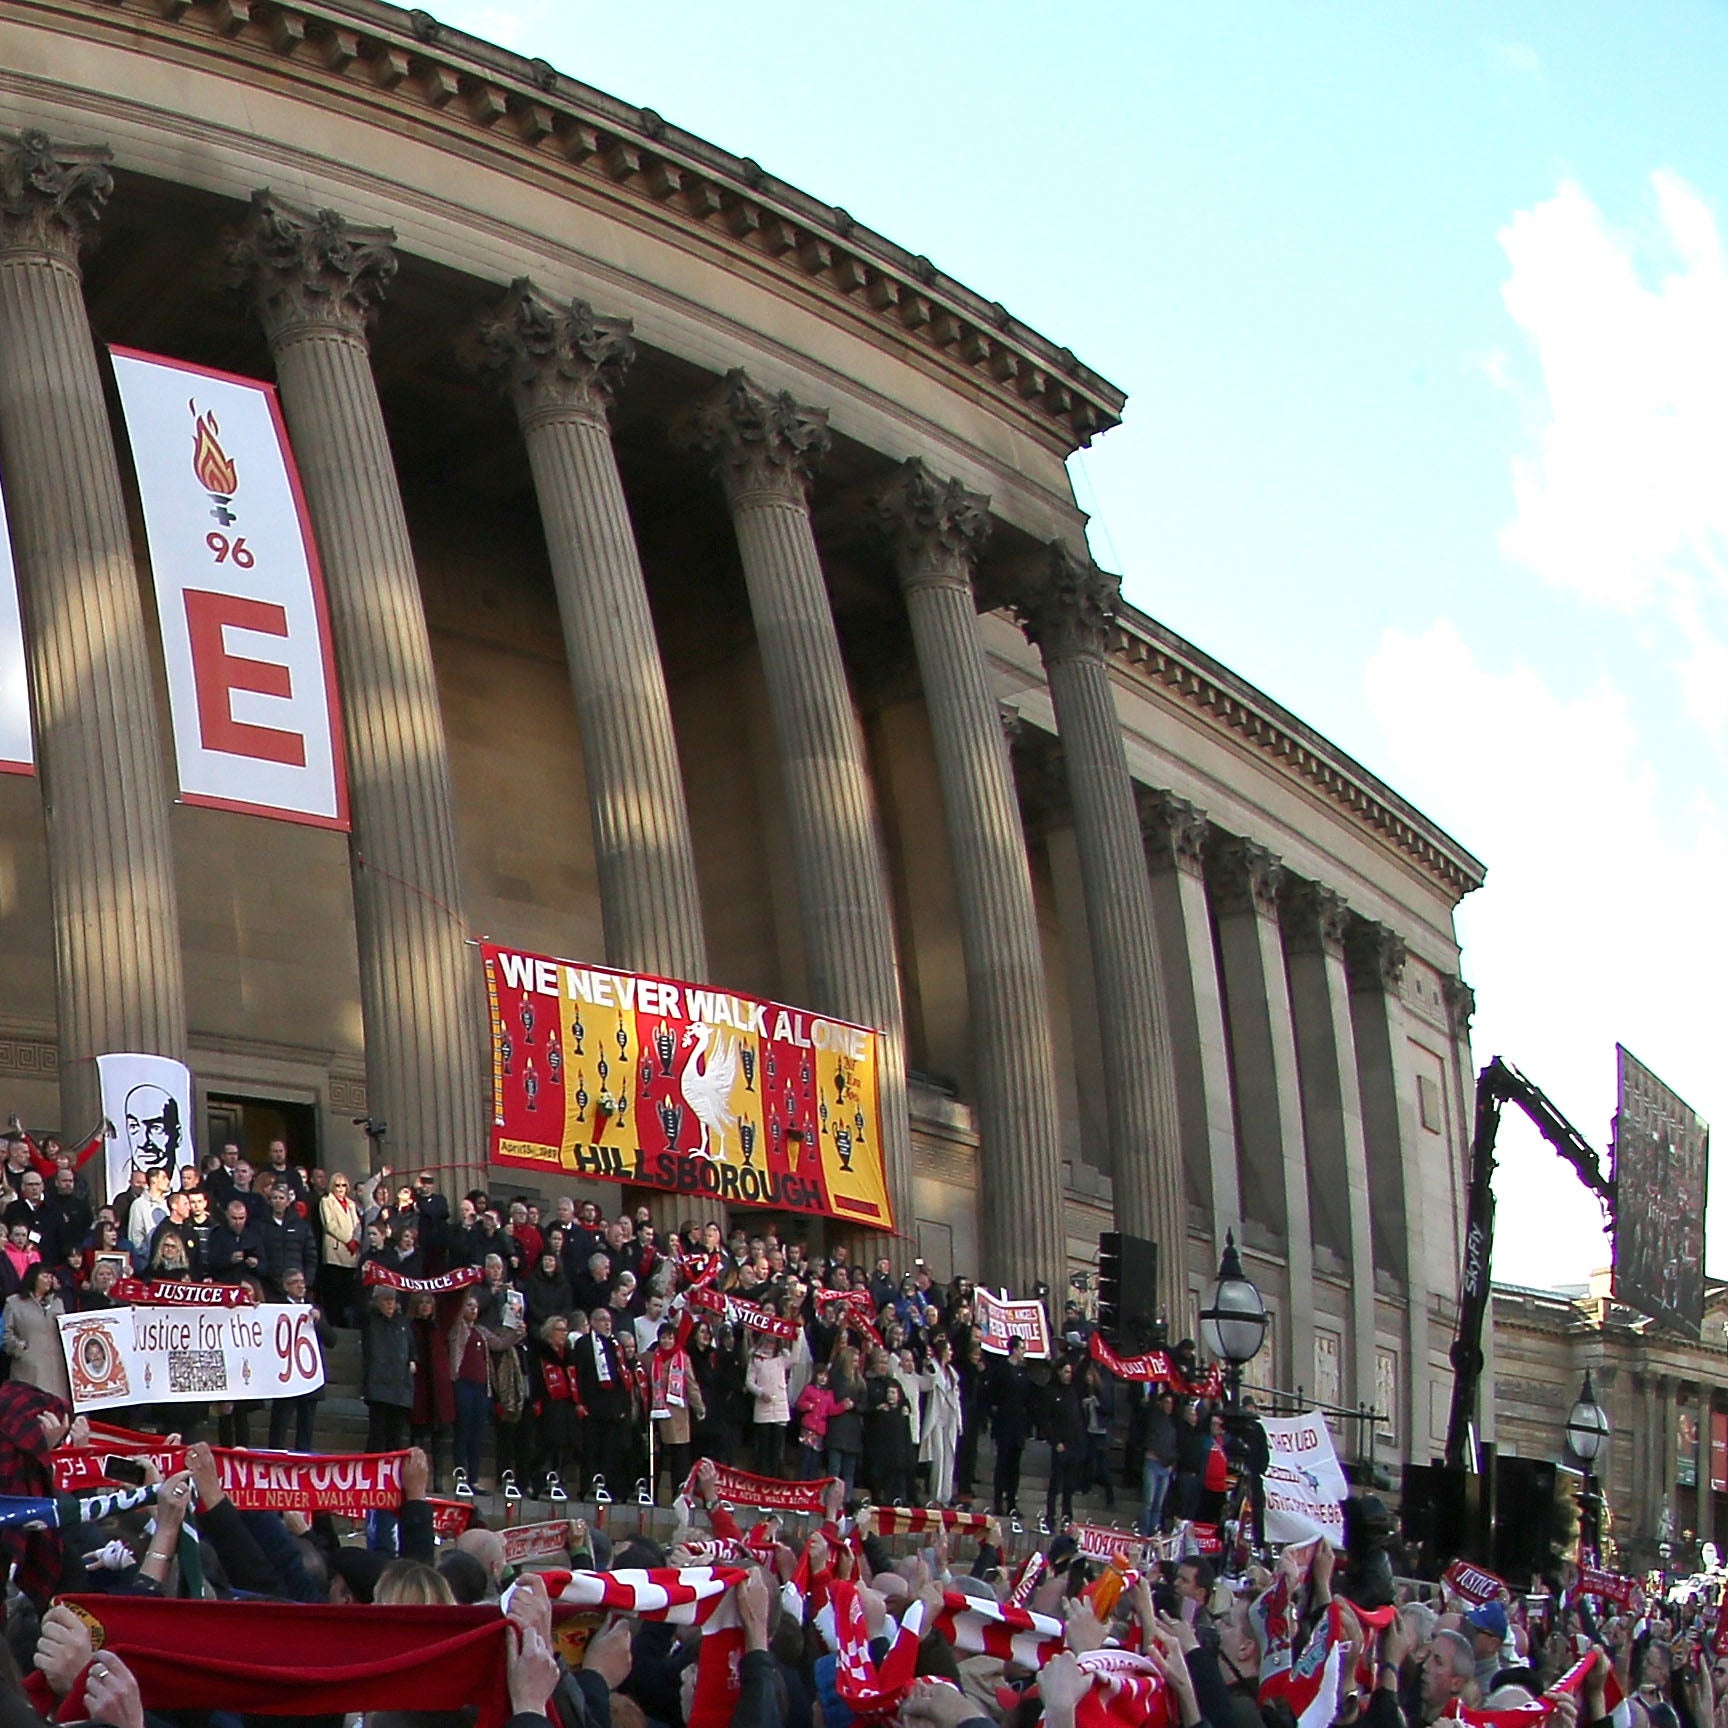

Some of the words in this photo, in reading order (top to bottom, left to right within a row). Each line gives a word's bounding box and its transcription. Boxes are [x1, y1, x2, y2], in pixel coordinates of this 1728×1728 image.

[206, 531, 254, 569] 96
[498, 952, 560, 997] WE
[567, 965, 682, 1018] NEVER
[684, 987, 769, 1039] WALK
[772, 1011, 867, 1061] ALONE
[573, 1143, 824, 1210] HILLSBOROUGH
[154, 1282, 223, 1302] JUSTICE
[400, 1276, 453, 1290] JUSTICE
[132, 1313, 191, 1351] Justice
[198, 1314, 223, 1350] for
[231, 1311, 262, 1348] the
[275, 1312, 318, 1382] 96
[1296, 1429, 1318, 1451] LIED
[266, 1491, 309, 1507] NEVER
[316, 1491, 355, 1506] WALK
[1456, 1568, 1499, 1599] JUSTICE
